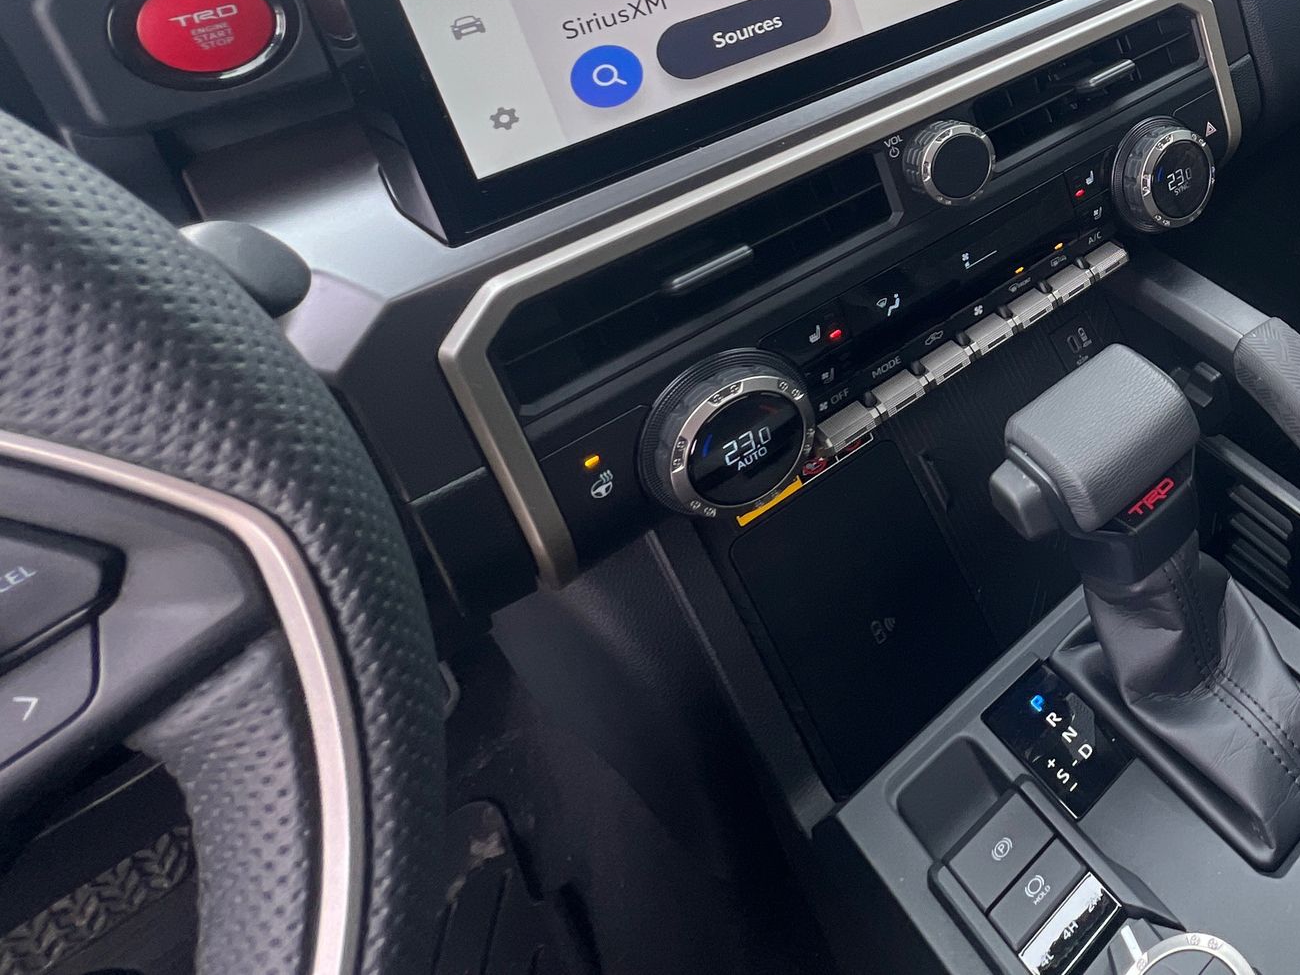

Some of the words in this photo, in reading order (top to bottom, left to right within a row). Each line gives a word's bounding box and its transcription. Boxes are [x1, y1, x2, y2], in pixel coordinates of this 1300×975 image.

[168, 4, 239, 27] TRD
[191, 22, 229, 36] ENGINE
[193, 28, 233, 44] START
[712, 15, 783, 49] Sources
[200, 36, 235, 50] STOP
[884, 135, 903, 148] VOL
[1088, 231, 1103, 245] A/C
[871, 355, 902, 379] MODE
[830, 387, 850, 405] OFF
[722, 426, 772, 466] 23.0
[737, 446, 768, 471] AUTO
[1127, 476, 1175, 516] TRD
[1030, 694, 1046, 712] P
[1045, 711, 1063, 728] R
[1062, 726, 1079, 744] N
[1077, 743, 1095, 760] D
[1056, 768, 1071, 785] S
[1032, 884, 1052, 906] HOLD
[1062, 919, 1079, 941] 4H
